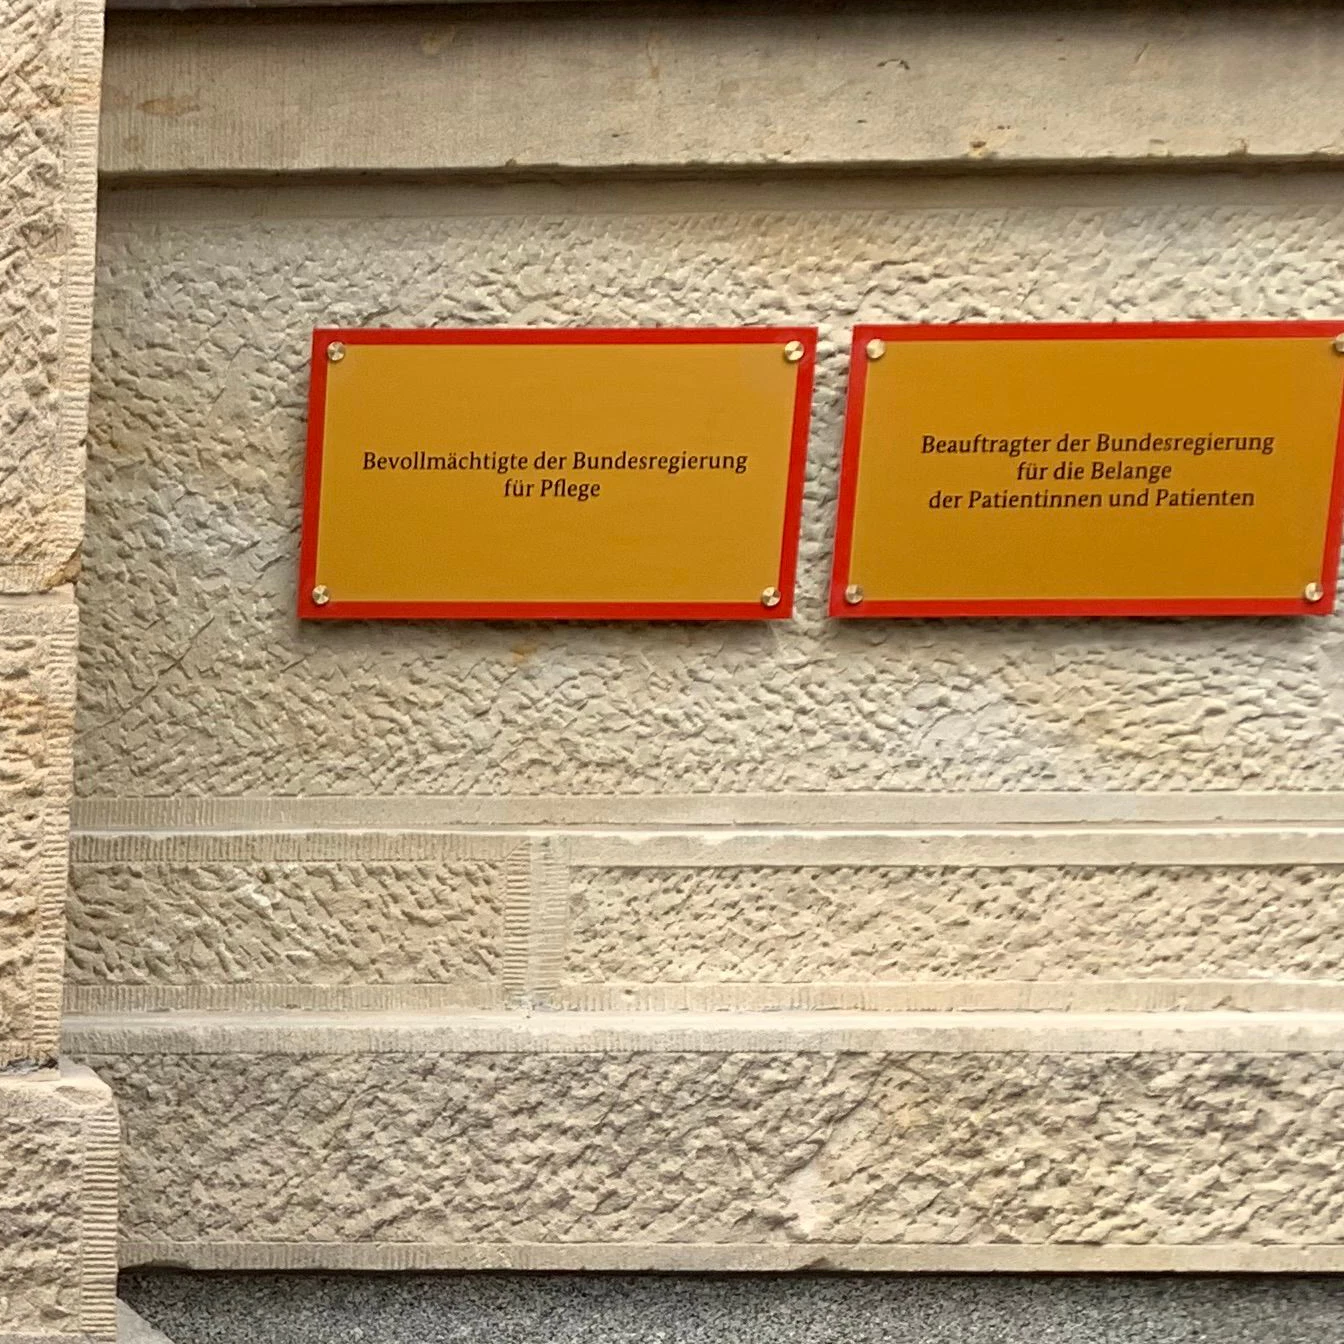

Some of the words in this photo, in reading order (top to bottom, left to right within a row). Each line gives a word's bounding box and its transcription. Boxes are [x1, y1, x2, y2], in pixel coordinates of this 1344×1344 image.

[920, 433, 1052, 459] Beauftragter
[1055, 432, 1092, 453] der
[1095, 432, 1275, 457] Bundesregierung
[362, 450, 529, 475] Bevollmächtigte
[533, 450, 568, 471] der
[571, 450, 748, 475] Bundesregierung
[1016, 461, 1049, 481] für
[1052, 460, 1085, 481] die
[1090, 460, 1172, 485] Belange
[503, 477, 535, 498] für
[539, 478, 601, 502] Pflege
[928, 489, 964, 510] der
[967, 488, 1103, 510] Patientinnen
[1108, 487, 1150, 508] und
[1154, 487, 1255, 507] Patienten
